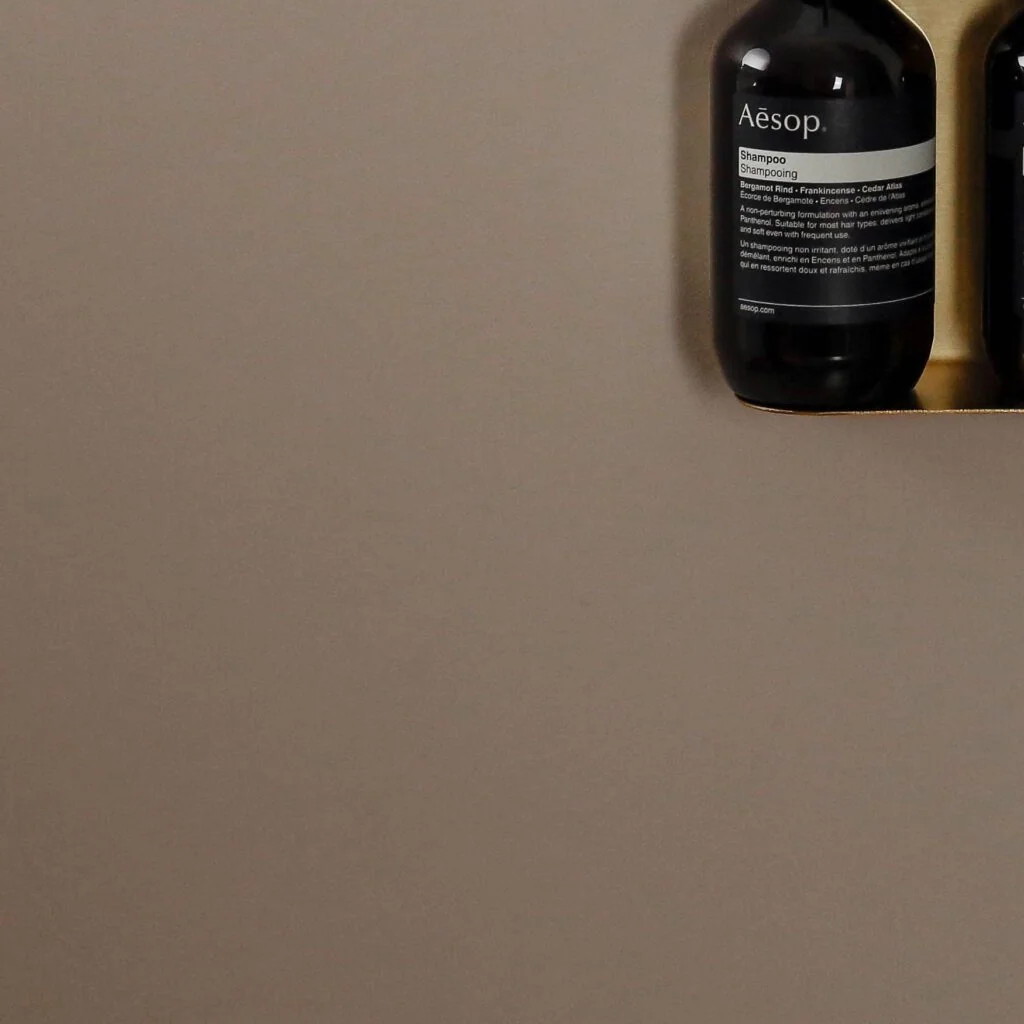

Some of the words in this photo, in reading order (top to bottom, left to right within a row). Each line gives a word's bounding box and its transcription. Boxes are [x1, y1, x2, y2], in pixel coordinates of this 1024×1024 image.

[740, 150, 786, 164] Shampoo
[740, 164, 798, 180] Shampooing
[740, 180, 773, 192] Bergamot
[775, 185, 794, 194] Rind
[800, 186, 856, 195] Frankincense
[862, 184, 884, 193] Cedar
[886, 182, 903, 191] Atlas
[773, 195, 814, 205] Bergamote
[820, 197, 849, 205] Encens
[878, 194, 887, 202] de
[740, 204, 745, 212] A
[746, 206, 796, 219] non-perturbing
[797, 210, 840, 219] formulation
[842, 210, 858, 219] with
[775, 219, 805, 229] Suitable
[807, 221, 817, 229] for
[820, 221, 838, 229] most
[841, 221, 855, 229] hair
[740, 226, 752, 234] and
[752, 227, 765, 236] soft
[766, 229, 783, 237] even
[784, 230, 800, 238] with
[801, 231, 833, 240] frequent
[740, 239, 749, 248] Un
[750, 241, 793, 254] shampooing
[811, 256, 840, 264] Encens
[842, 256, 851, 264] et
[740, 261, 749, 270] qui
[750, 262, 759, 270] en
[760, 263, 797, 273] ressortent
[798, 266, 818, 274] doux
[819, 266, 828, 274] et
[740, 303, 775, 314] aesop.com
